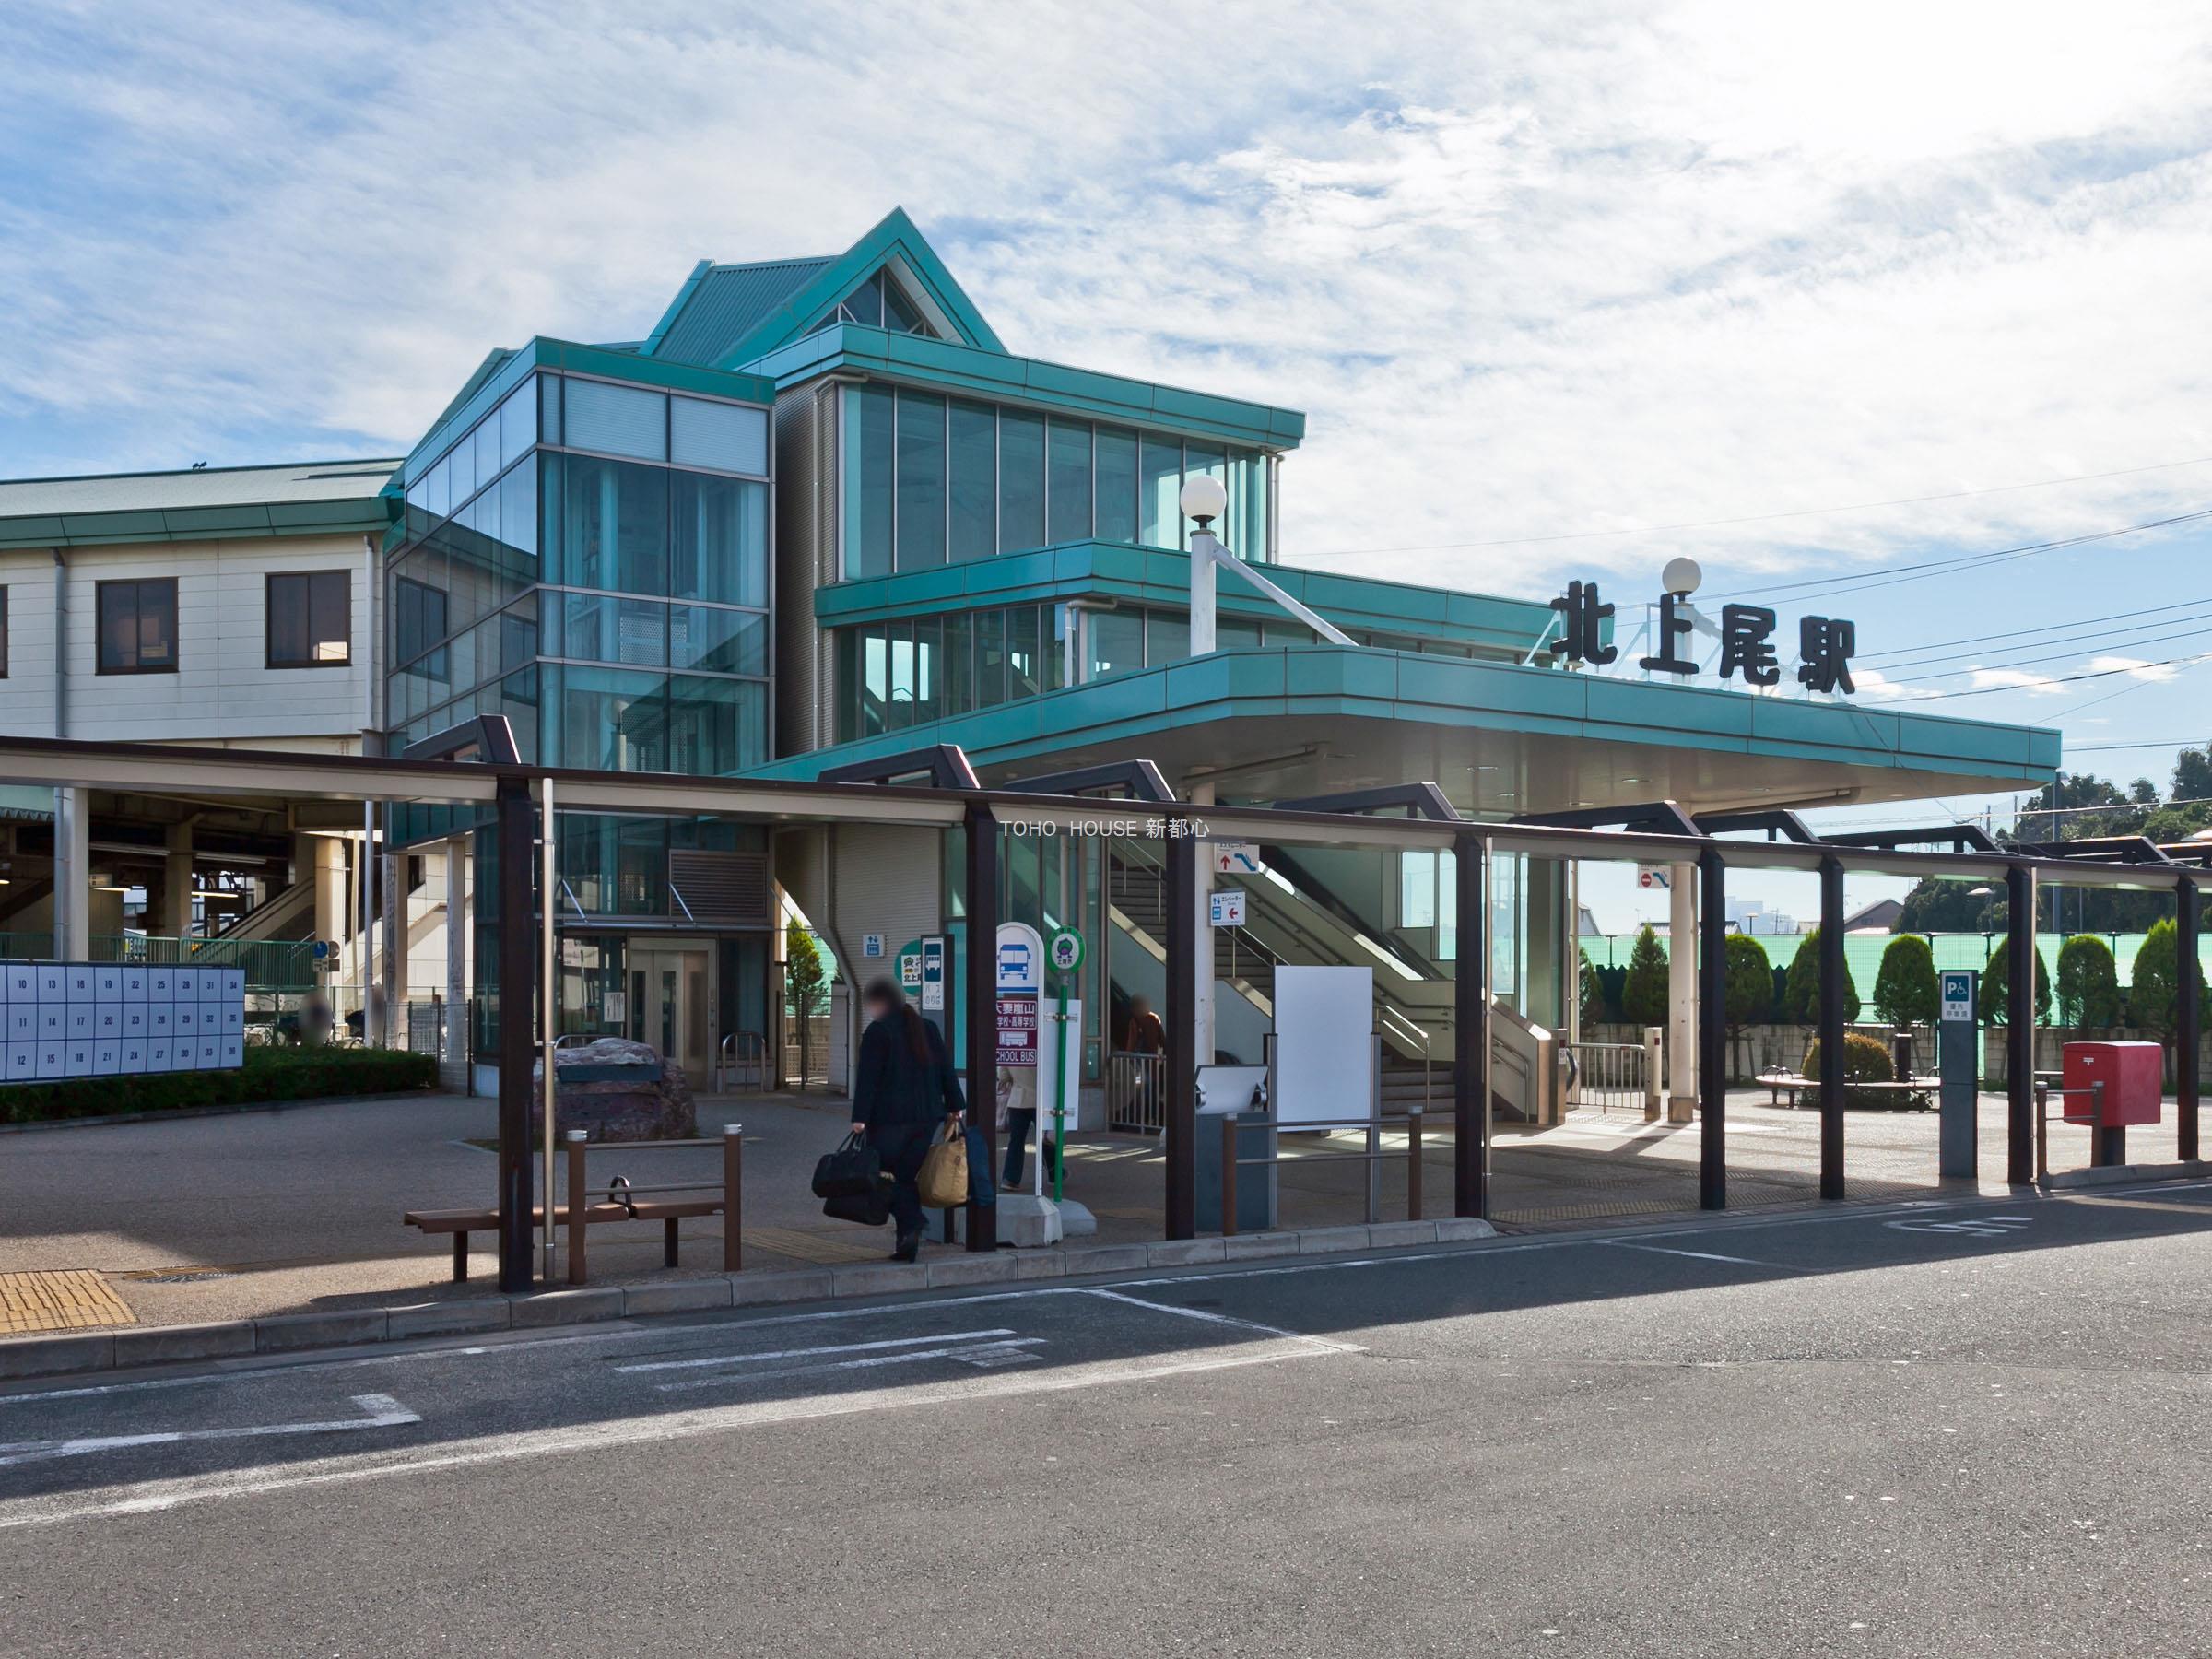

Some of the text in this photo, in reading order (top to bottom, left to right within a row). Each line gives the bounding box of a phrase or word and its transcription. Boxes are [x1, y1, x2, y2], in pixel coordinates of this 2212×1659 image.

[1549, 580, 1856, 695] 北上尾駅
[18, 980, 27, 988] 10
[49, 980, 55, 988] 13
[77, 980, 85, 989] 16
[132, 981, 139, 989] 22
[158, 981, 165, 989] 25
[182, 981, 190, 989] 28
[19, 1018, 27, 1027] 11
[49, 1018, 55, 1026] 14
[77, 1017, 85, 1025] 17
[105, 1017, 112, 1025] 20
[132, 1016, 139, 1024] 23
[158, 1016, 165, 1024] 26
[182, 1015, 190, 1023] 29
[18, 1055, 26, 1065] 12
[48, 1054, 54, 1064] 15
[76, 1053, 83, 1062] 18
[103, 1053, 111, 1061] 21
[130, 1052, 137, 1060] 24
[156, 1050, 163, 1058] 27
[206, 1048, 213, 1056] 33
[1020, 1051, 1035, 1062] BUS
